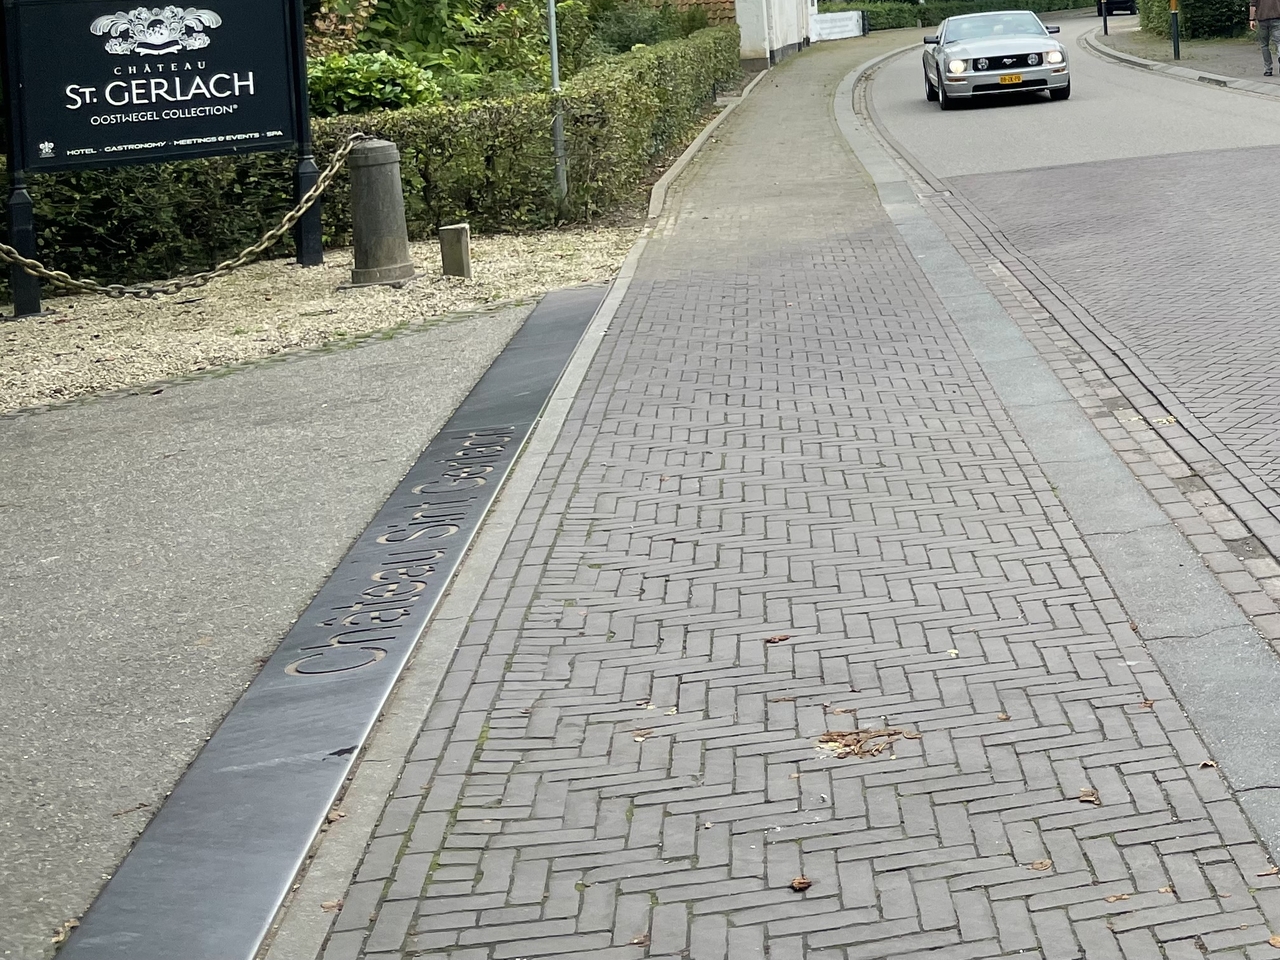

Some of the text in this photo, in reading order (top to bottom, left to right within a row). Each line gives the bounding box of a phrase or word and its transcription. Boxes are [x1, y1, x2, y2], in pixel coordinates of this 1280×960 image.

[114, 60, 206, 75] CHÂTEAU
[105, 71, 255, 107] GERLACH
[90, 108, 160, 126] OOSTWEGEL
[67, 147, 97, 156] HOTEL
[104, 140, 167, 153] GASTRONOMY
[173, 135, 217, 146] MEETINGS
[225, 132, 260, 141] EVENTS
[266, 129, 283, 137] SPA
[411, 425, 517, 497] Gerlach
